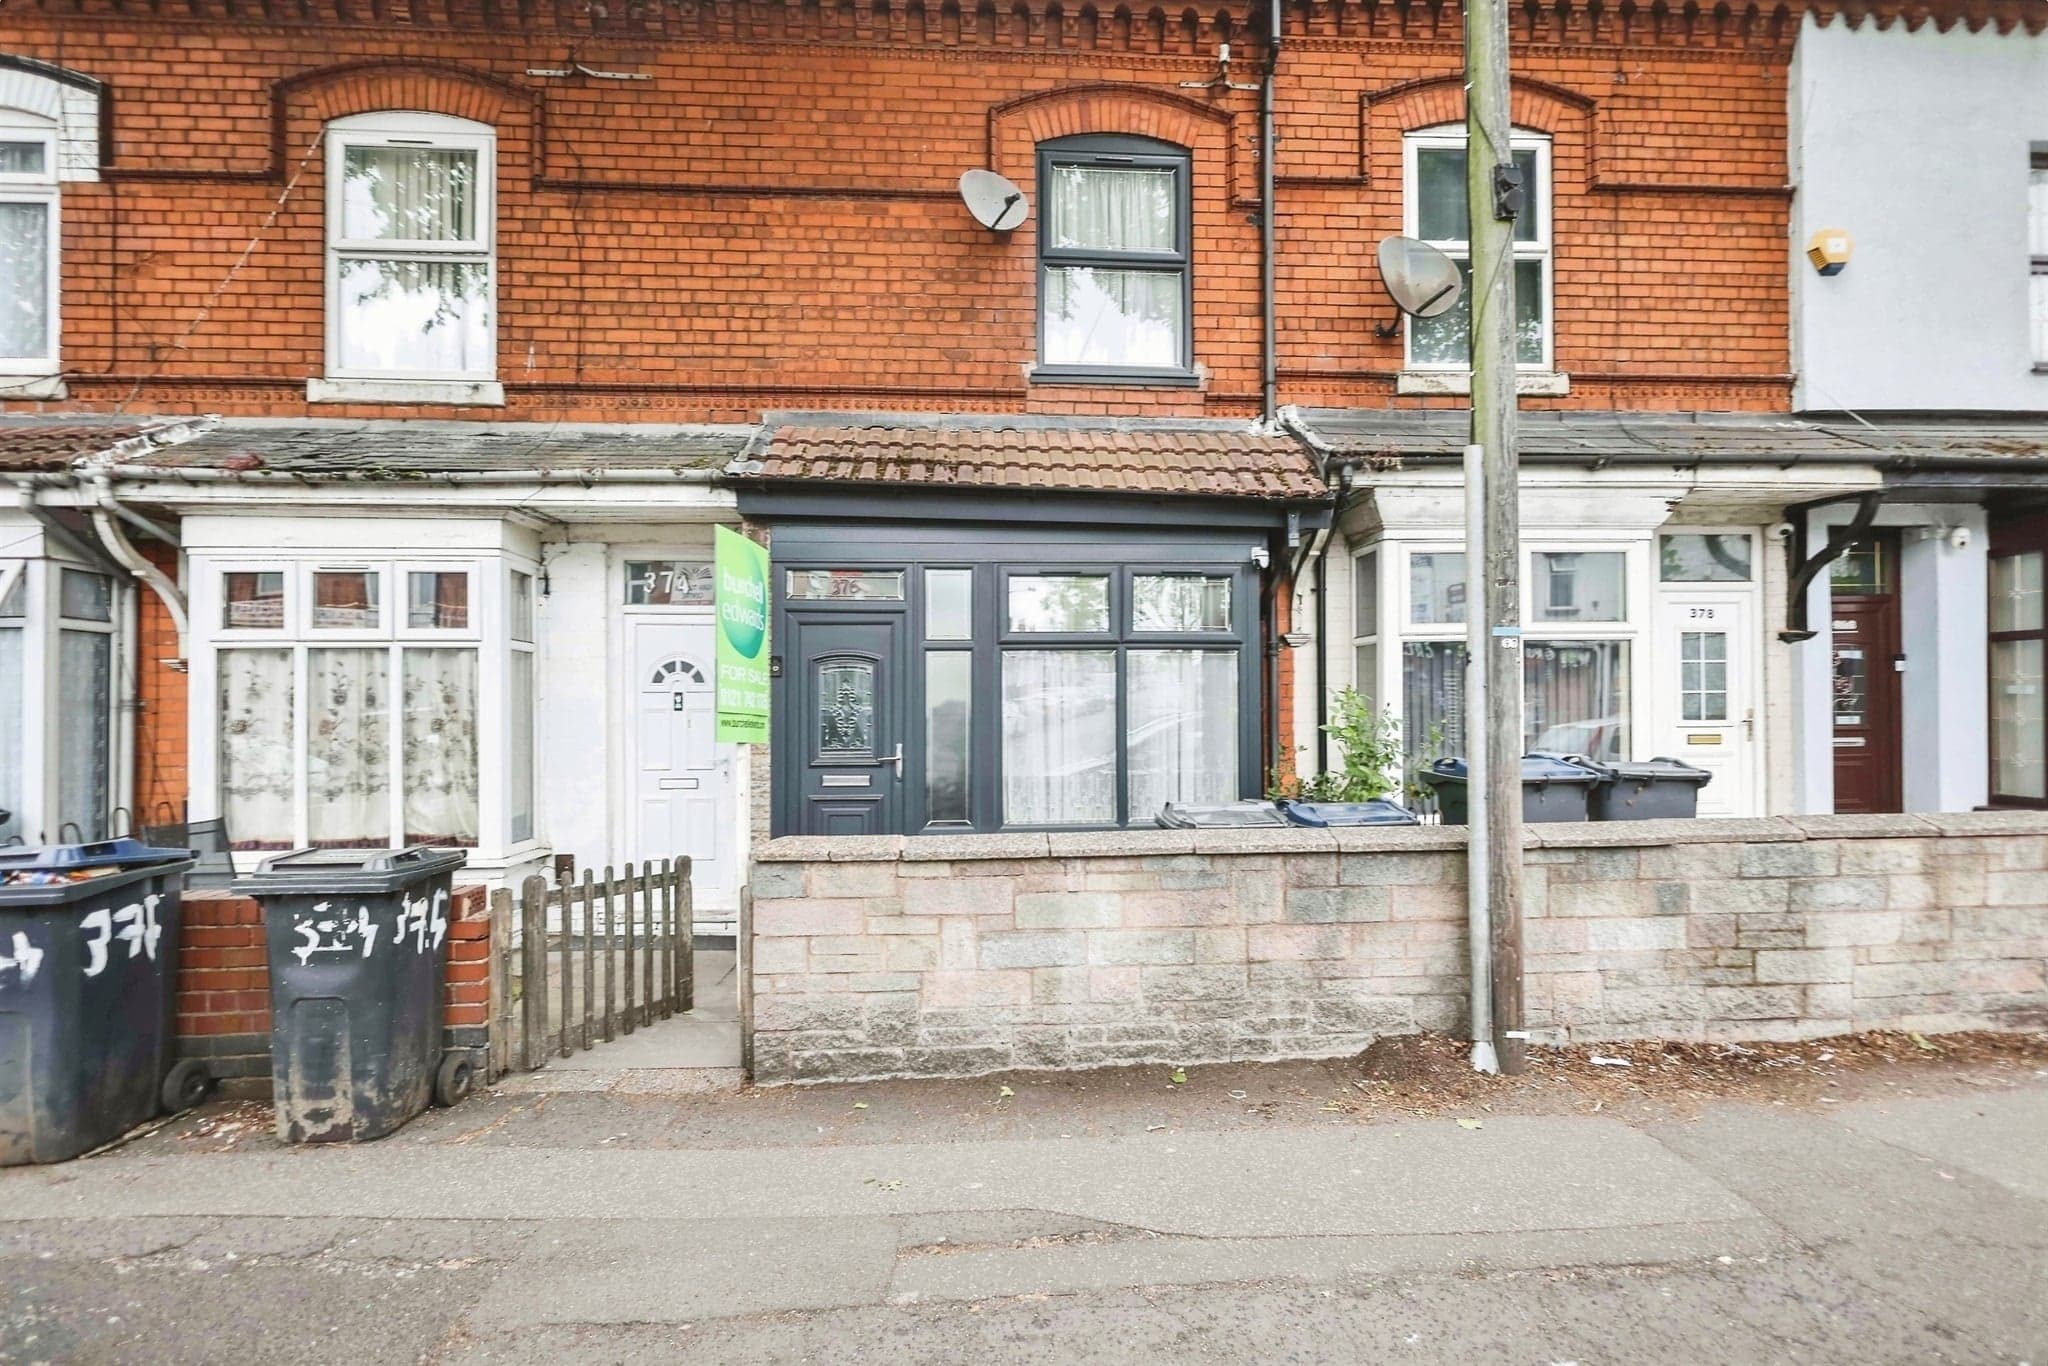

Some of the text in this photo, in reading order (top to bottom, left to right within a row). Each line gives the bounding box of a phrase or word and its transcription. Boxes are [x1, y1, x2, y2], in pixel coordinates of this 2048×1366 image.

[643, 570, 689, 594] 374
[830, 579, 860, 595] 376
[1690, 608, 1714, 619] 378
[720, 664, 745, 681] FOR
